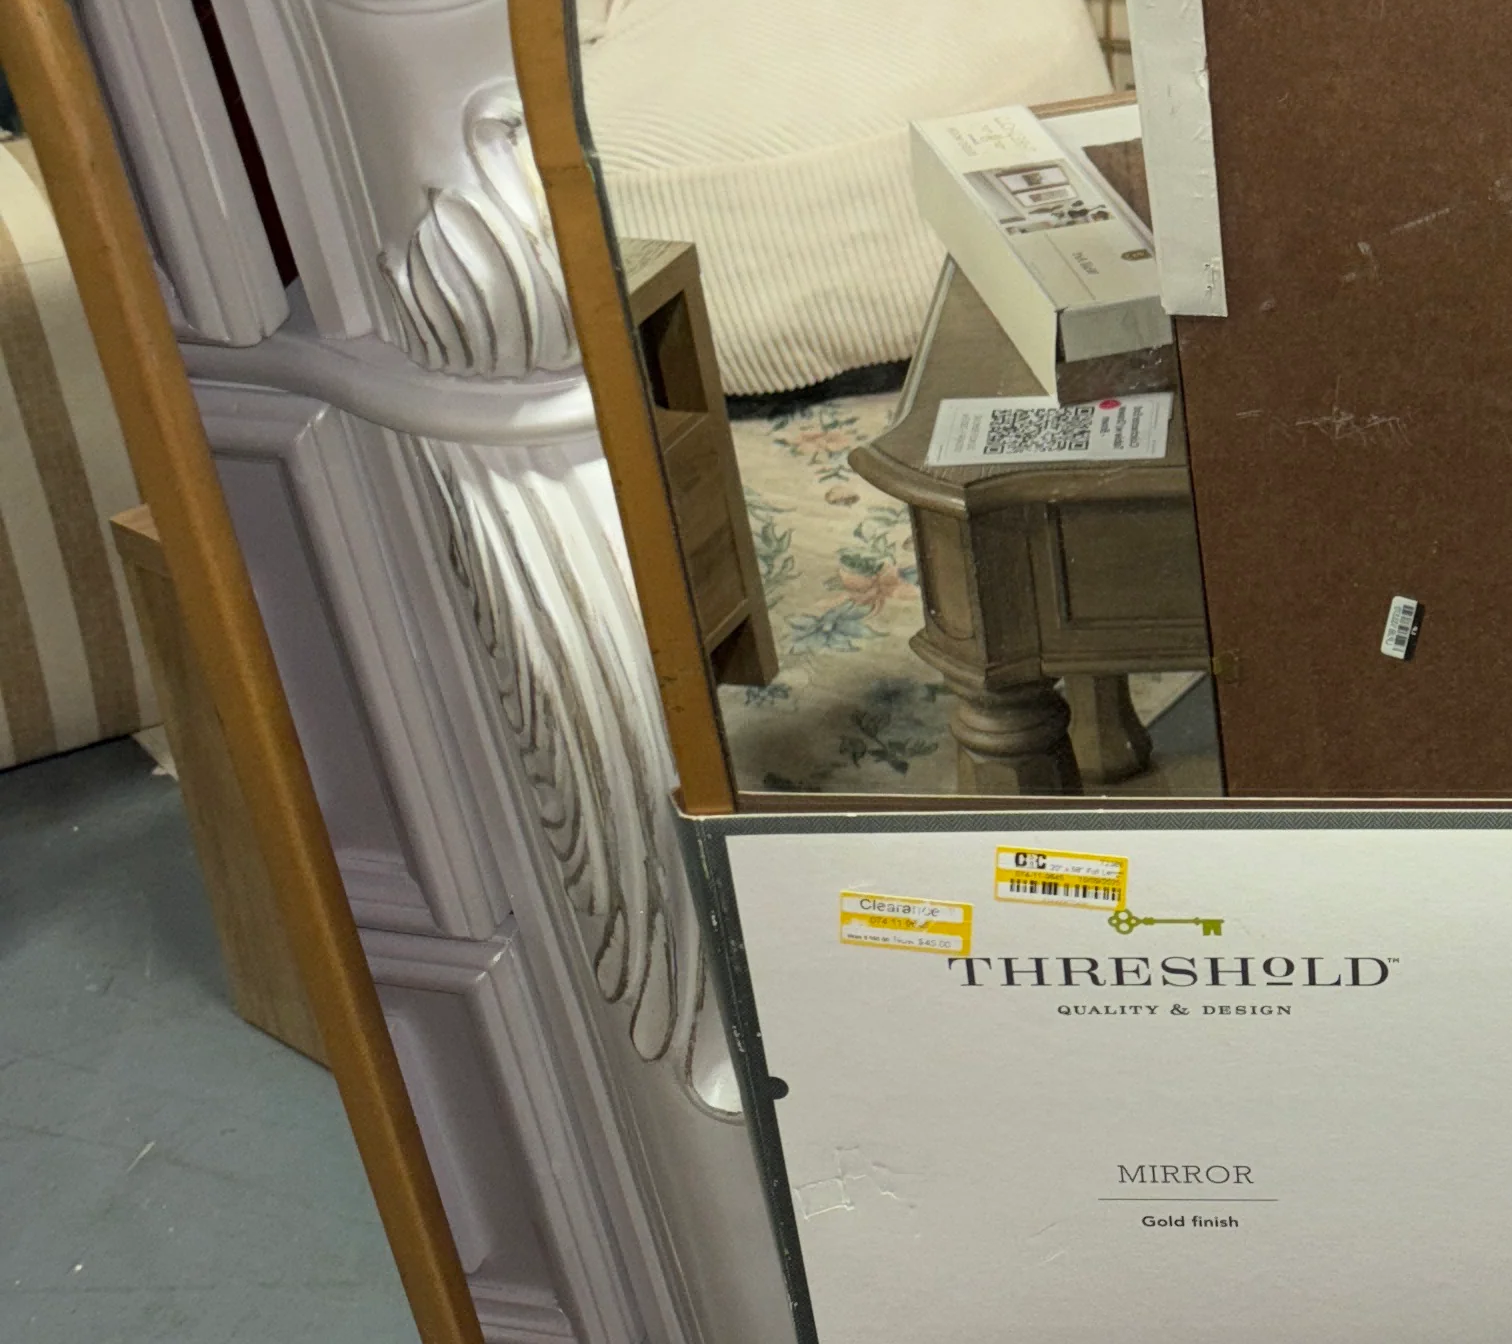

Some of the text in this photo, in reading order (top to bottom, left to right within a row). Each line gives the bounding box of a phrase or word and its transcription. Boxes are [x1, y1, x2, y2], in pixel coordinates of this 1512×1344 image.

[1057, 1003, 1293, 1016] QUALITY & DESIGN
[1117, 1164, 1255, 1184] MIRROR
[1141, 1215, 1239, 1228] Gold finish
